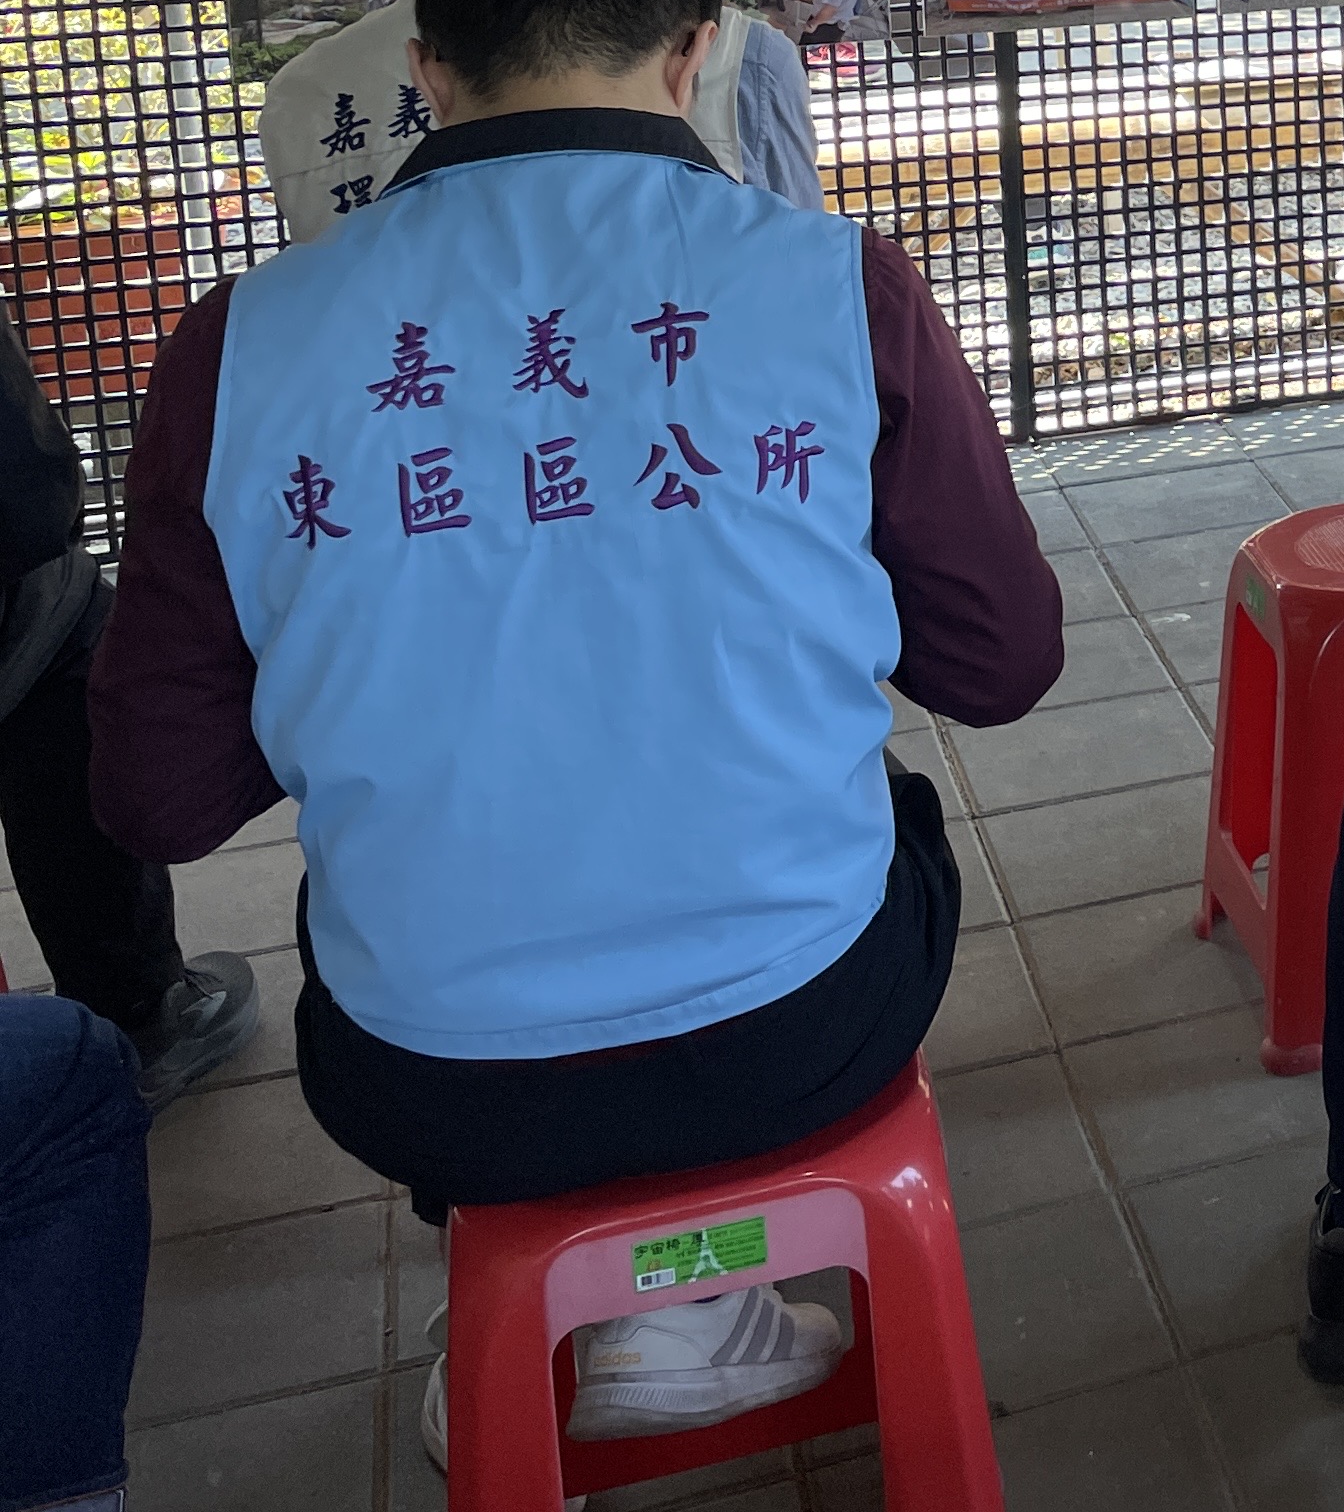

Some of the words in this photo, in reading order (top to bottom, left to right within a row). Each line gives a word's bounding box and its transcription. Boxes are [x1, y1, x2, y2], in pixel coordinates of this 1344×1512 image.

[366, 301, 710, 414] 嘉義市
[282, 421, 825, 550] 東區區公所
